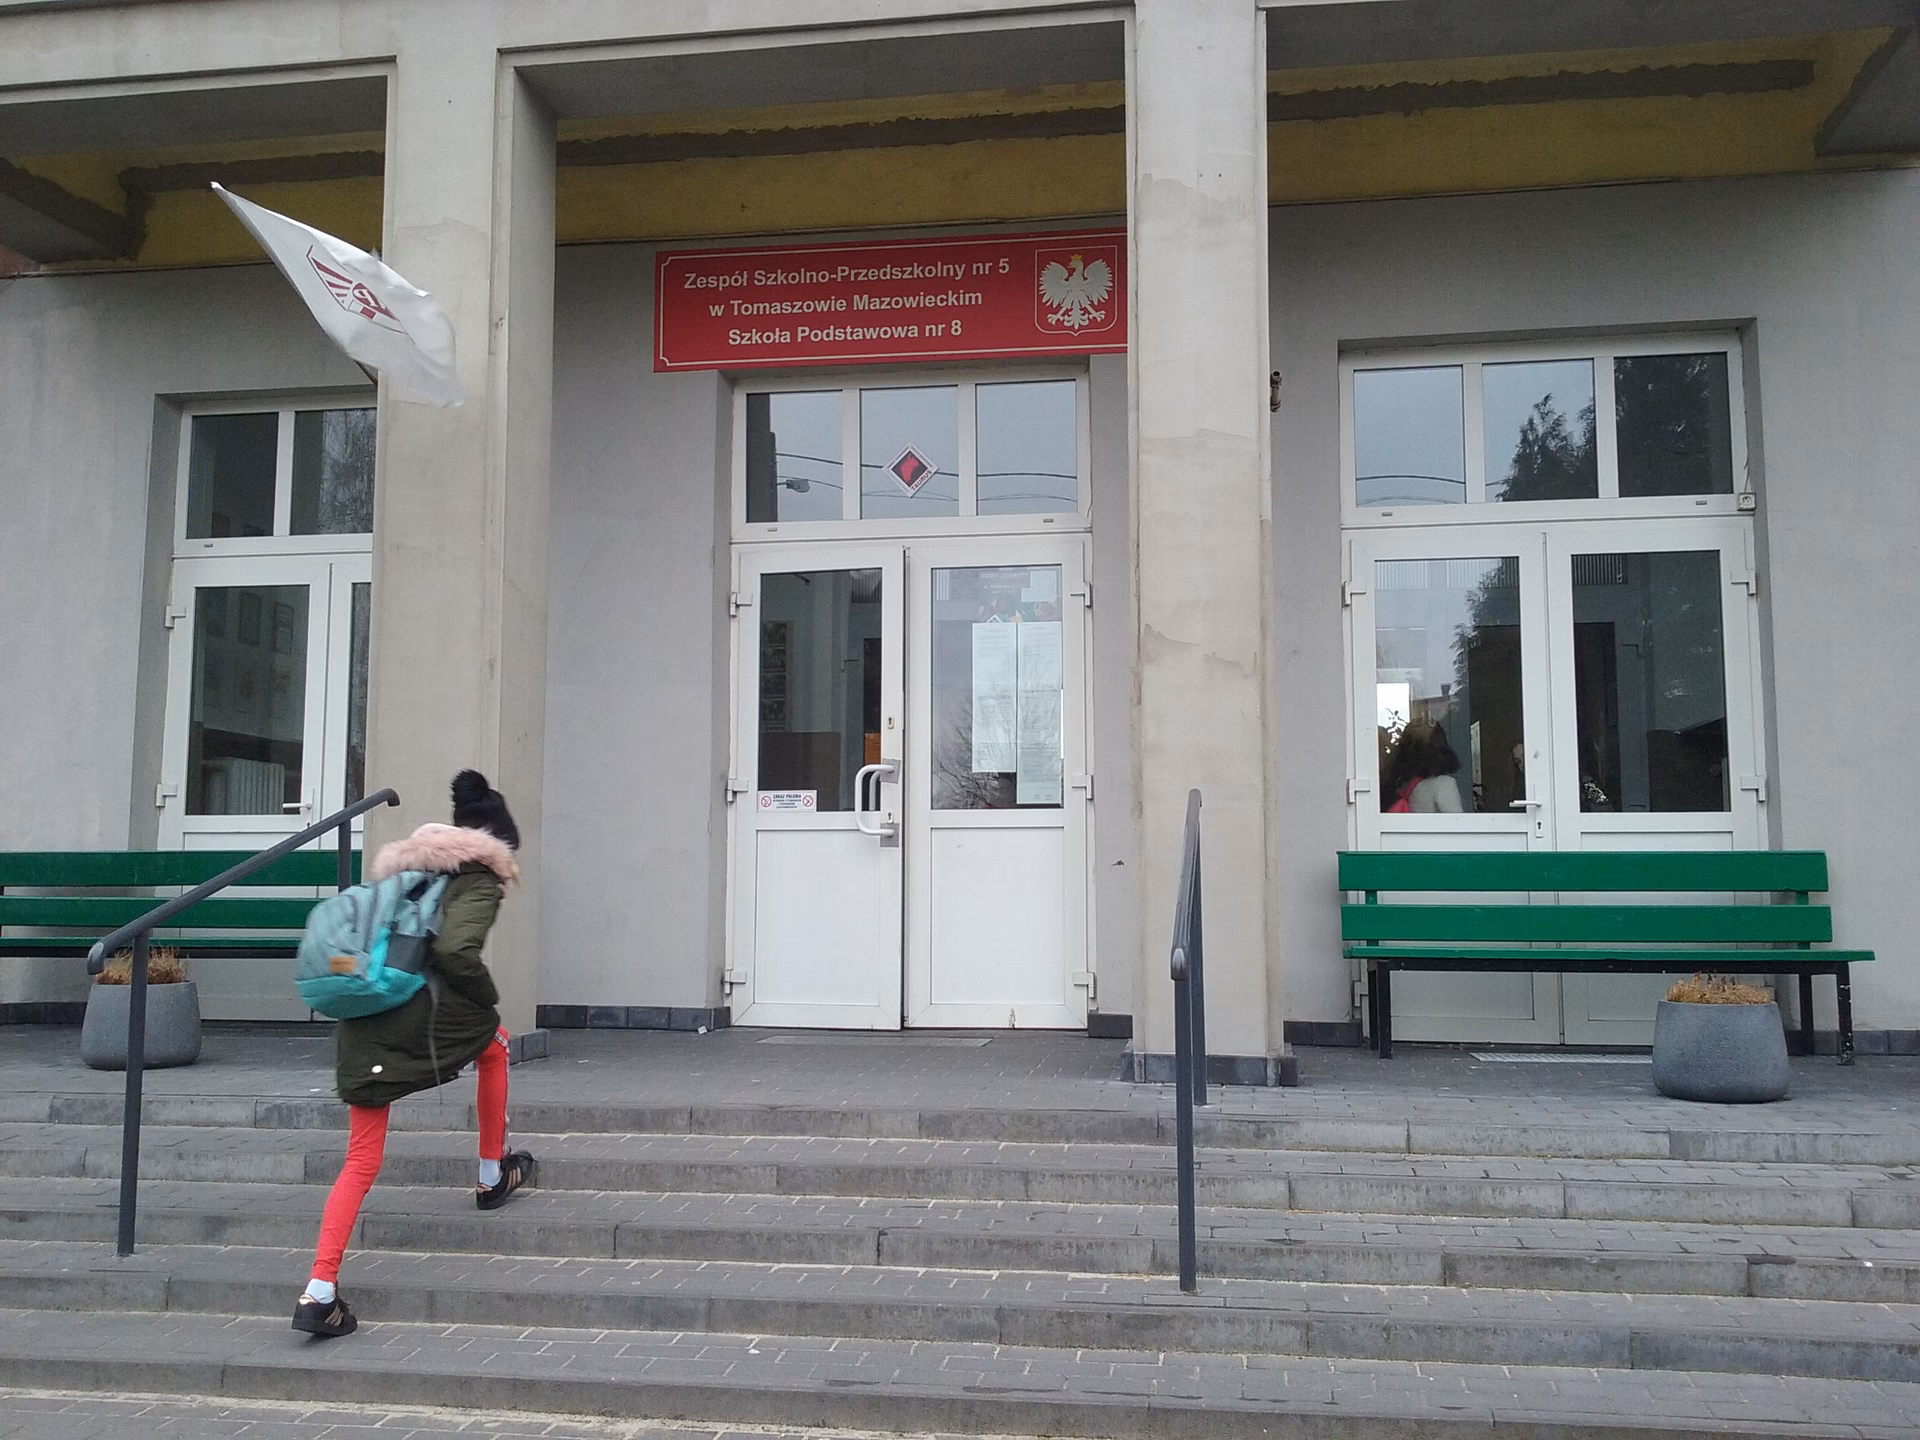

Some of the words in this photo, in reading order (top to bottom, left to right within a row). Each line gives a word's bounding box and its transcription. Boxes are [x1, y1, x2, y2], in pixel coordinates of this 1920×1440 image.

[684, 271, 748, 291] Zespół
[753, 262, 966, 286] Szkolno-Przedszkolny
[972, 262, 993, 275] nr
[998, 258, 1010, 273] 5
[709, 304, 725, 317] w
[730, 296, 847, 316] Tomaszowie
[853, 290, 983, 310] Mazowieckim
[728, 328, 791, 345] Szkoła
[797, 325, 918, 342] Podstawowa
[925, 323, 945, 337] nr
[950, 319, 962, 336] 8
[911, 470, 932, 491] TAURUS
